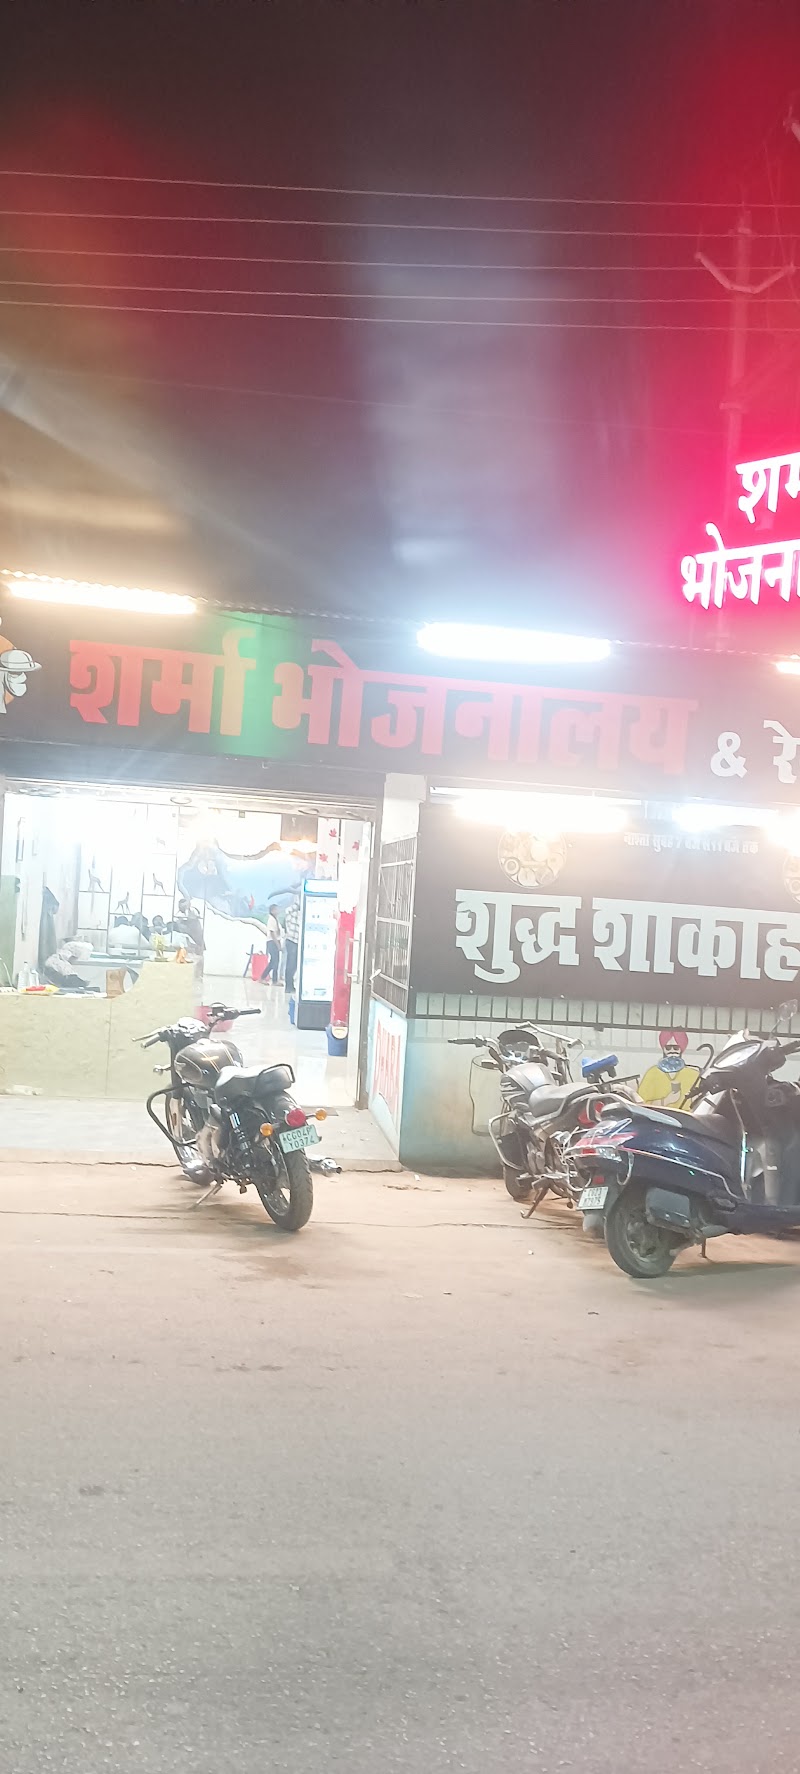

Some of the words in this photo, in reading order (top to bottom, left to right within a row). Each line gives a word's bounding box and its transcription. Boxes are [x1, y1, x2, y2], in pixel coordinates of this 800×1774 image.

[69, 628, 256, 736] शर्मा
[272, 638, 698, 776] भोजनालय
[710, 731, 747, 777] &
[456, 889, 582, 983] शुद्ध
